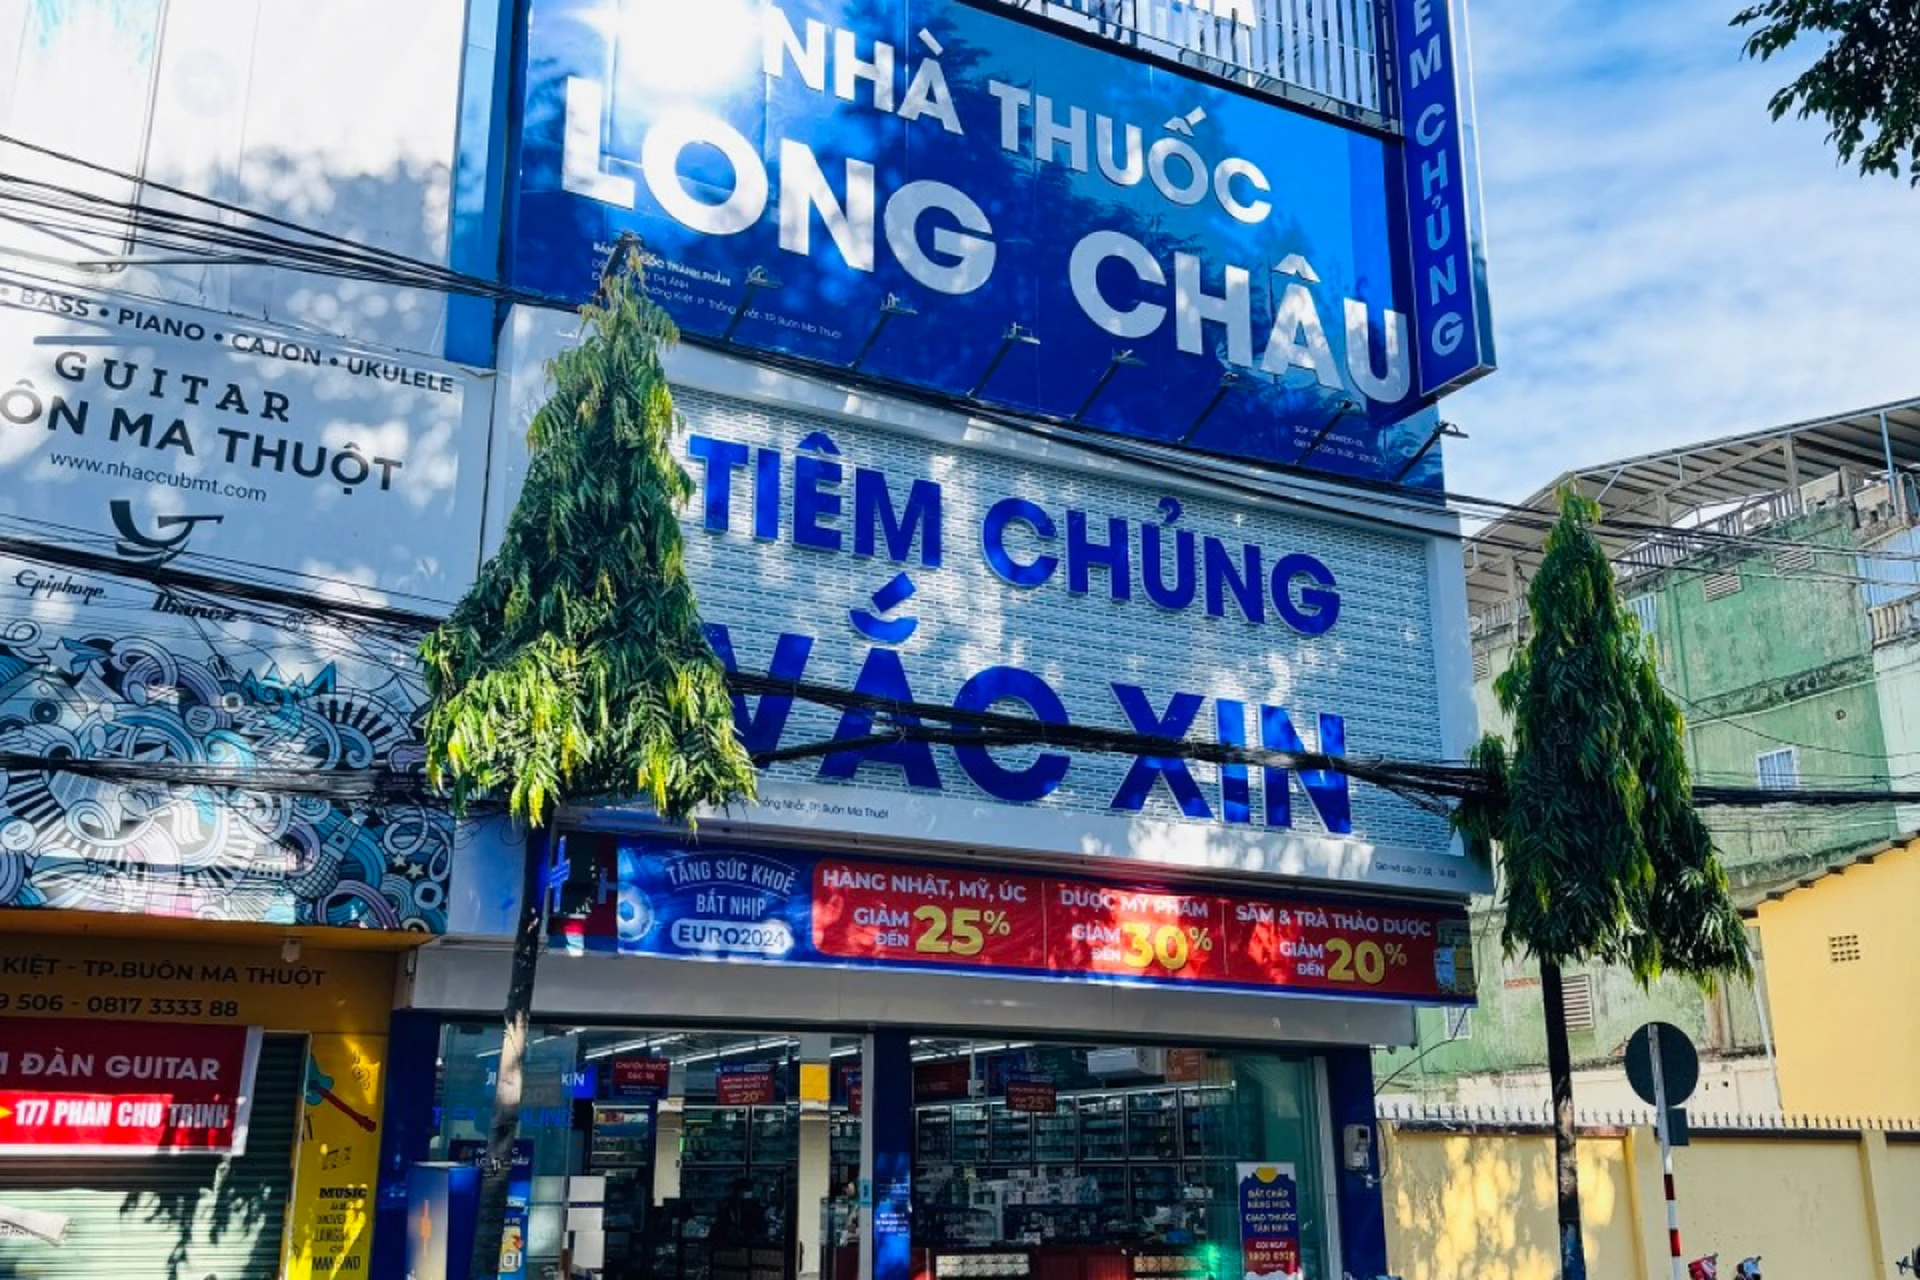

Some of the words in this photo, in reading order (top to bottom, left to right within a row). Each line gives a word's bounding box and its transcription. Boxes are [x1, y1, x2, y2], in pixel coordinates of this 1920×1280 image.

[763, 0, 963, 136] NHÀ
[988, 79, 1272, 224] THUỐC
[561, 75, 997, 295] LONG
[1069, 229, 1410, 402] CHÂU
[1415, 103, 1464, 356] CHỦNG
[19, 287, 90, 318] BASS
[118, 308, 206, 341] PIANO
[231, 333, 321, 367] CAJON
[347, 357, 454, 394] UKULELE
[55, 351, 290, 423] GUITAR
[109, 407, 195, 457] MA
[217, 426, 403, 495] THUỘT
[50, 450, 267, 502] www.nhaccubmt.com
[689, 431, 942, 570] TIÊM
[982, 496, 1341, 636] CHỦNG
[704, 571, 1071, 801] VẮC
[1110, 681, 1352, 834] XIN
[716, 857, 747, 881] SỨC
[823, 866, 886, 891] HÀNG
[999, 879, 1027, 902] ÚC
[854, 903, 910, 928] GIẢM
[913, 904, 1011, 956] 25%
[1071, 920, 1121, 942] GIẢM
[1279, 911, 1291, 925] &
[1294, 908, 1329, 929] TRÀ
[1332, 910, 1379, 932] THẢO
[1383, 919, 1432, 940] DƯỢC
[678, 924, 785, 948] EURO2024
[875, 930, 910, 947] ĐẾN
[1279, 936, 1324, 959] GIẢM
[3, 956, 60, 980] KIỆT
[200, 967, 238, 983] MA
[246, 966, 326, 990] THUỘT
[1297, 960, 1325, 977] ĐẾN
[1326, 938, 1407, 985] 20%
[16, 994, 64, 1011] 506
[87, 996, 141, 1014] 0817
[149, 999, 202, 1016] 3333
[209, 1000, 239, 1017] 88
[20, 1047, 94, 1076] ĐÀN
[105, 1056, 221, 1080] GUITAR
[15, 1100, 49, 1126] 177
[52, 1101, 112, 1127] PHAN
[117, 1102, 163, 1127] CHU
